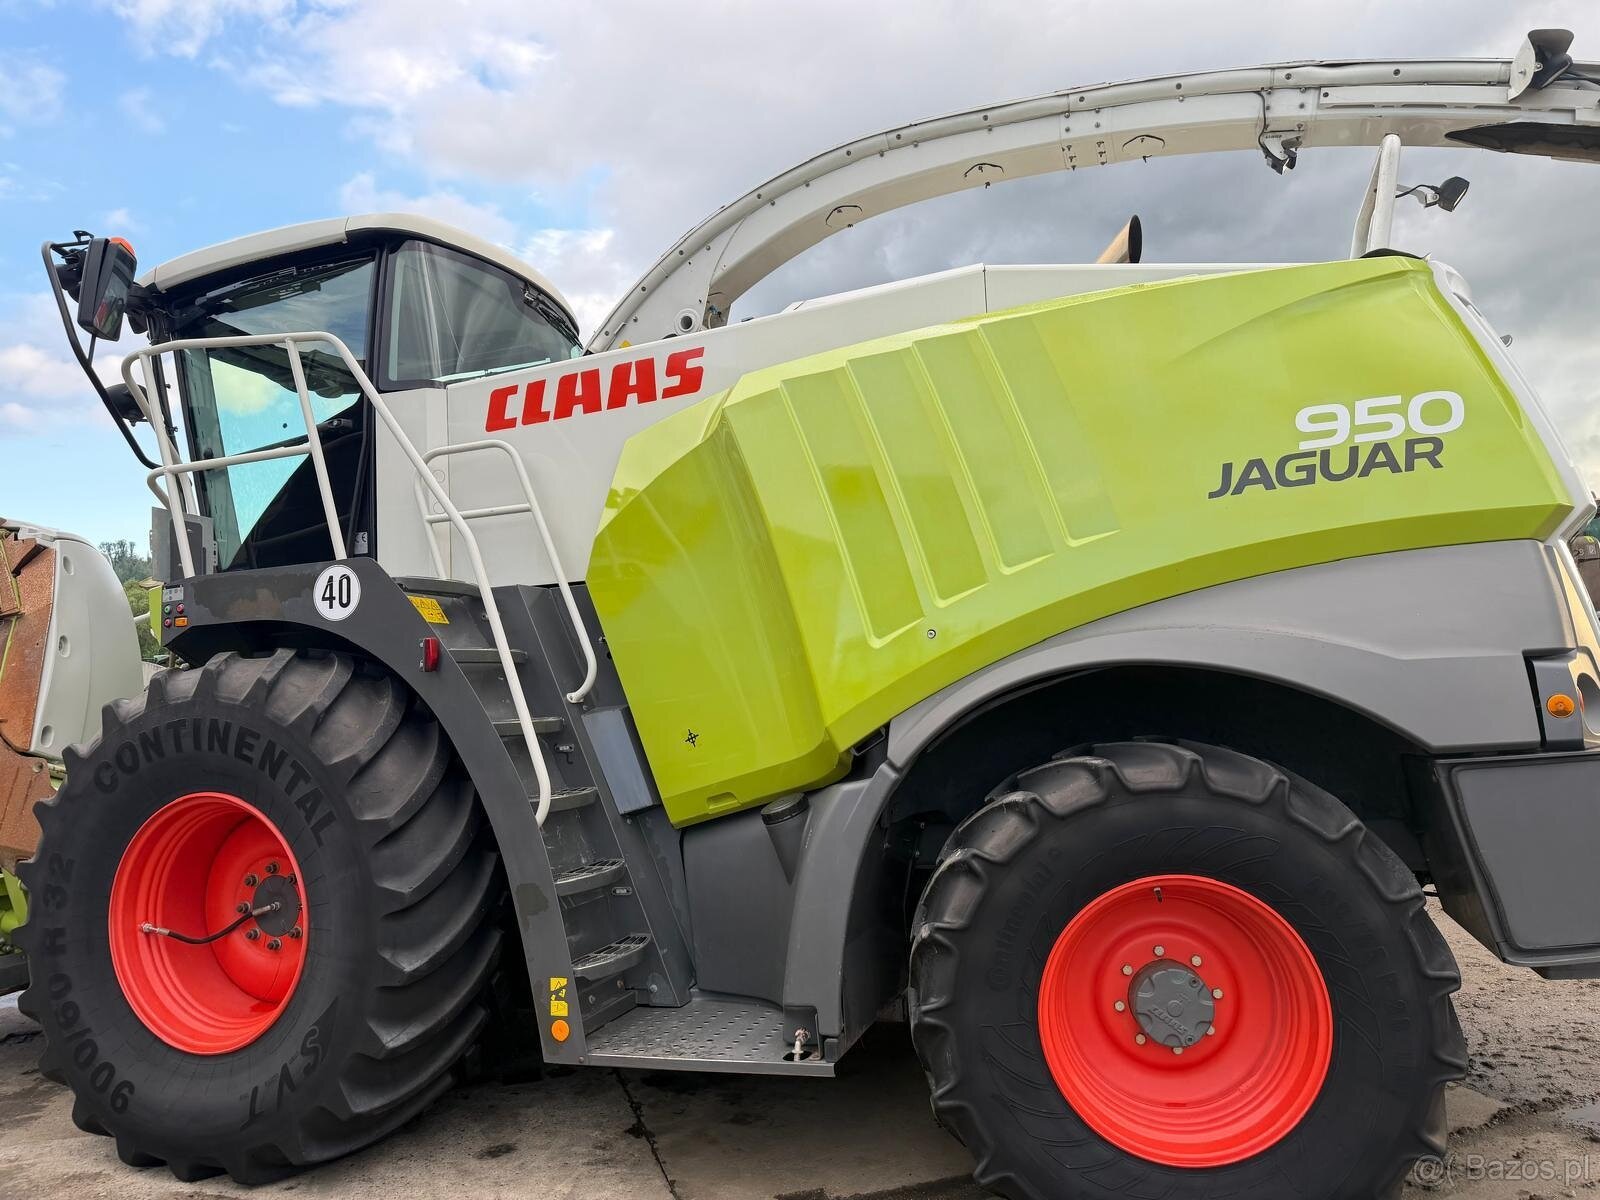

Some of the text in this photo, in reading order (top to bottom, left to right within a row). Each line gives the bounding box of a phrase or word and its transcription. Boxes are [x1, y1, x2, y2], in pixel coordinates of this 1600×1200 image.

[485, 346, 705, 433] CLAAS
[1295, 390, 1465, 450] 950
[1208, 436, 1444, 500] JAGUAR
[321, 573, 352, 610] 40
[93, 717, 337, 847] CONTINENTAL
[42, 853, 76, 911] 32
[46, 972, 136, 1116] 900/60
